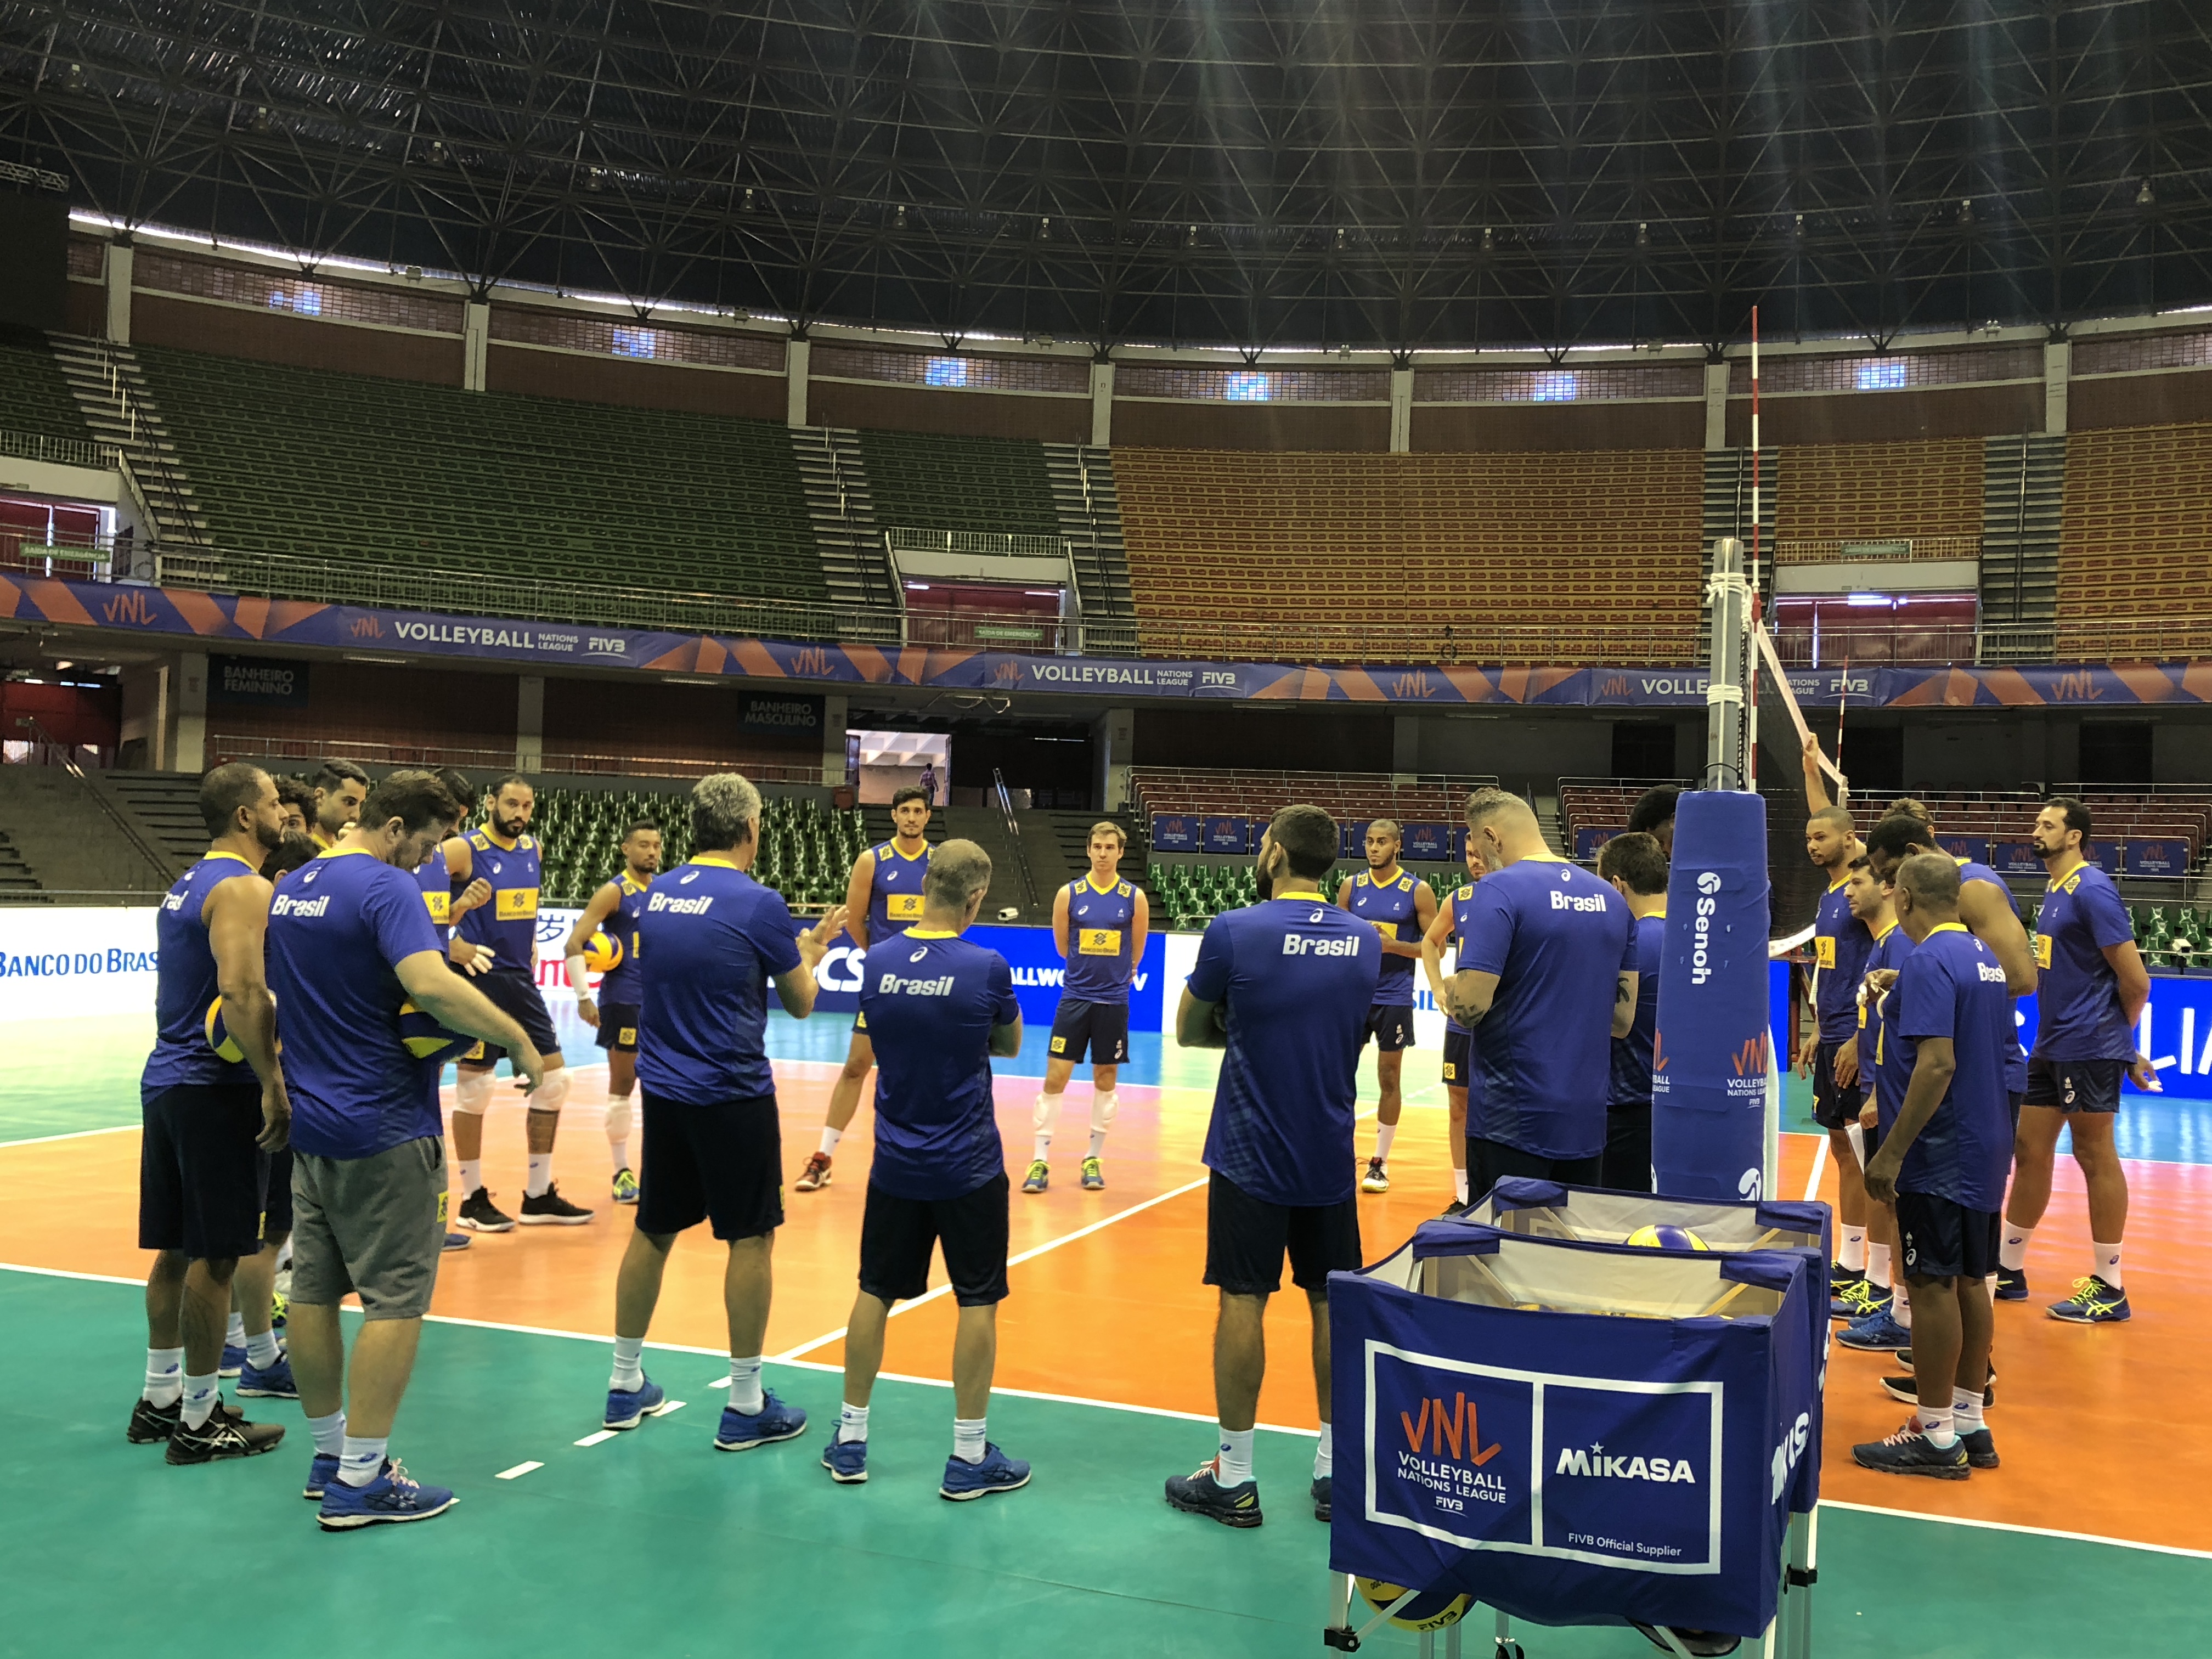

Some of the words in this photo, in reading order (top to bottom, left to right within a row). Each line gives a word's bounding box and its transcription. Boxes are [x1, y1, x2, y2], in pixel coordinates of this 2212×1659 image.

[103, 590, 157, 625] VNL
[350, 615, 385, 639] VNL
[394, 621, 534, 649] VOLLEYBALL
[538, 633, 578, 644] NATIONS
[538, 641, 573, 652] LEAGUE
[589, 636, 625, 652] FIVB
[791, 646, 834, 675] VNL
[224, 666, 294, 682] BANHEIRO
[994, 659, 1024, 682] VNL
[1031, 665, 1154, 685] VOLLEYBALL
[1157, 670, 1193, 678] NATIONS
[1157, 678, 1188, 686] LEAGUE
[1203, 672, 1235, 685] FIVB
[224, 679, 292, 695] FEMININO
[1392, 669, 1436, 698] VNL
[1600, 675, 1633, 697] VNL
[1641, 679, 1711, 695] VOLLE
[2051, 669, 2104, 701] VNL
[751, 701, 812, 714] BANHEIRO
[745, 712, 816, 726] MASCULINO
[1165, 819, 1187, 833] VNL
[1215, 820, 1236, 835] VNL
[1415, 826, 1436, 842] VNL
[270, 894, 330, 917] Brasil
[648, 892, 713, 916] Brasil
[1550, 890, 1606, 912] Brasil
[1282, 934, 1360, 956] Brasil
[1691, 897, 1716, 984] Senoh
[74, 953, 102, 975] DO
[106, 947, 159, 973] BRAS
[878, 973, 954, 997] Brasil
[1652, 1085, 1670, 1093] EAGUE
[1400, 1392, 1503, 1466] VNL
[1398, 1451, 1506, 1491] VOLLEYBALL
[1398, 1468, 1451, 1493] NATIONS
[1456, 1484, 1506, 1504] LEAGUE
[1436, 1496, 1463, 1511] FIVB
[1568, 1533, 1594, 1545] FIVB
[1596, 1537, 1634, 1552] Official
[1637, 1542, 1682, 1558] Supplier
[1417, 1610, 1458, 1630] FIVB
